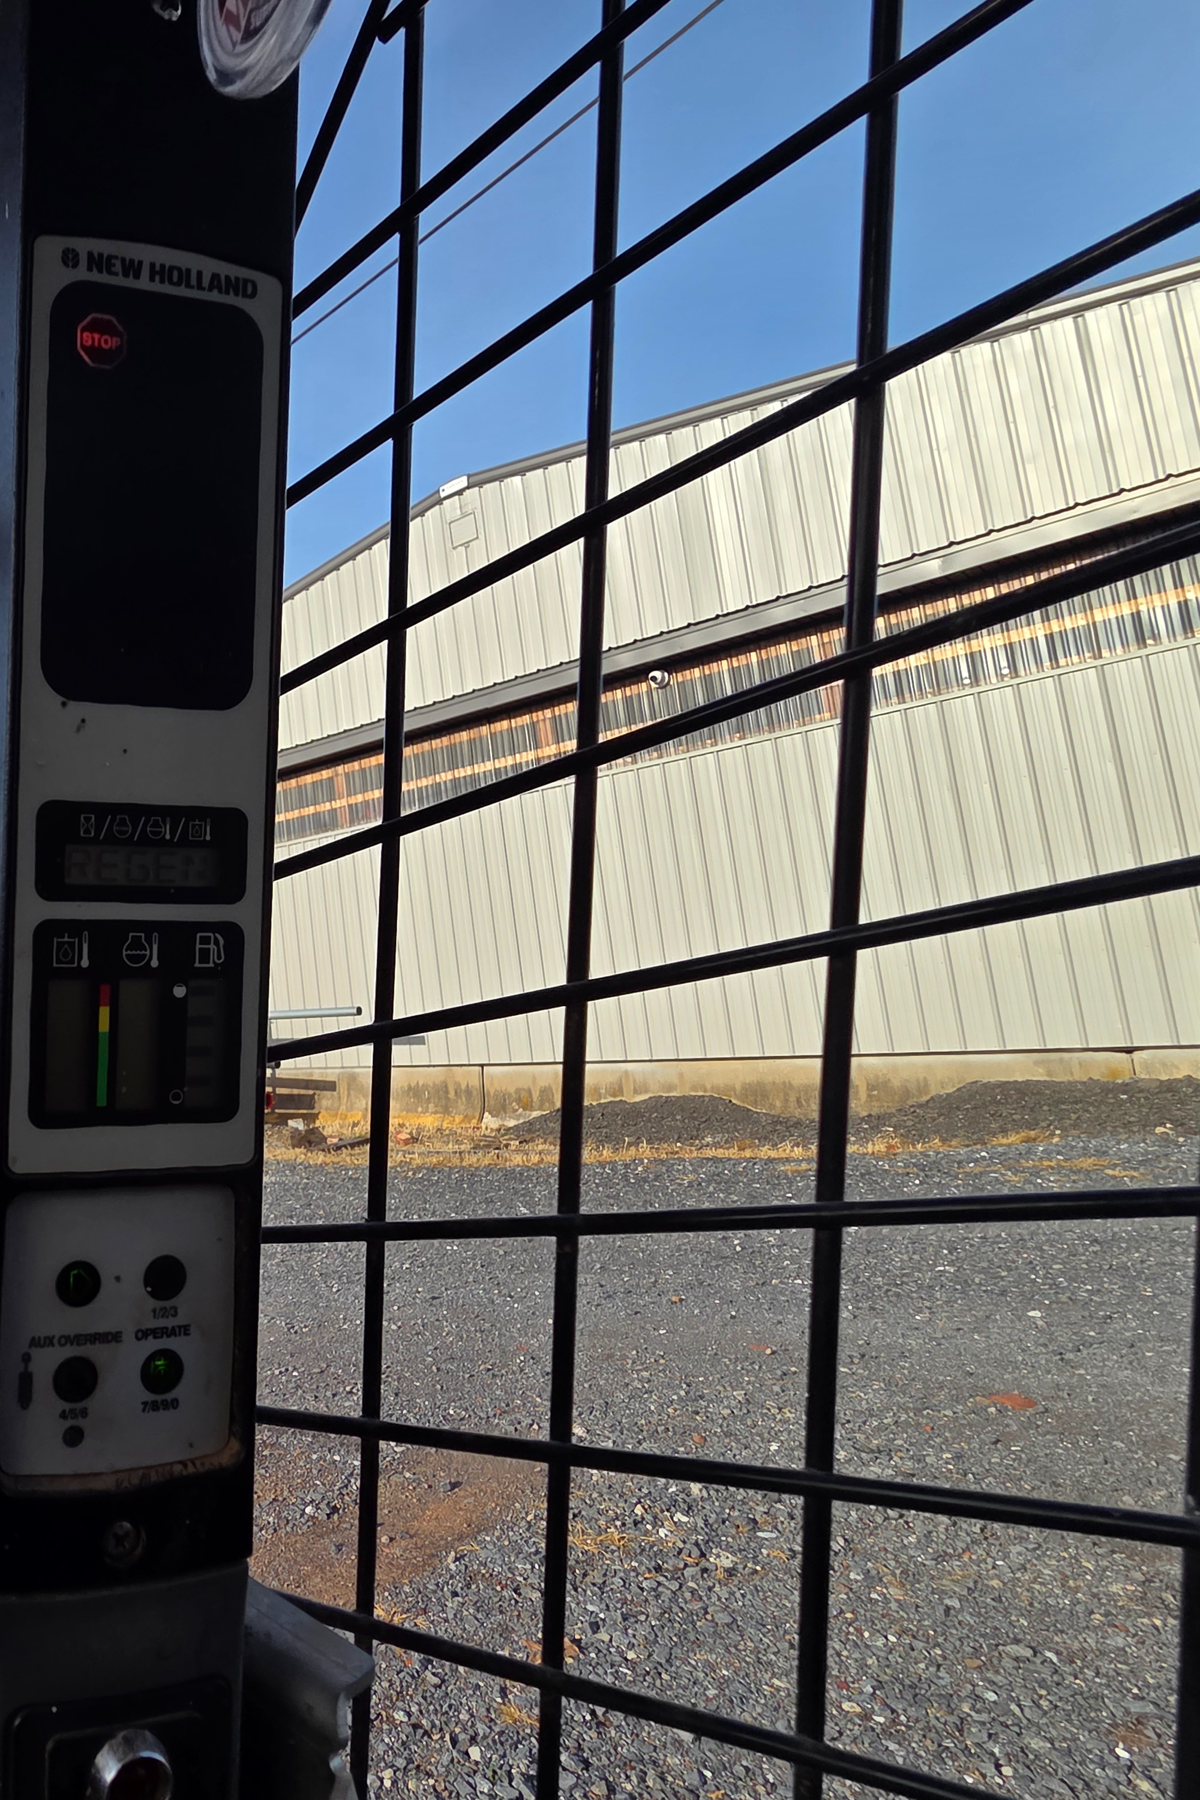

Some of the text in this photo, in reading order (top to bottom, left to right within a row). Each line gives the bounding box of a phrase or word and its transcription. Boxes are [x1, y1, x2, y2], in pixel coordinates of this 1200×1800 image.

[86, 250, 258, 299] NEW HOLLAND
[82, 331, 121, 350] STOP
[151, 1305, 179, 1320] 1/2/3
[28, 1331, 123, 1349] AUX OVERRIDE
[134, 1324, 191, 1342] OPERATE
[58, 1407, 89, 1421] 4/5/6
[141, 1397, 179, 1413] 7/8/9/0
